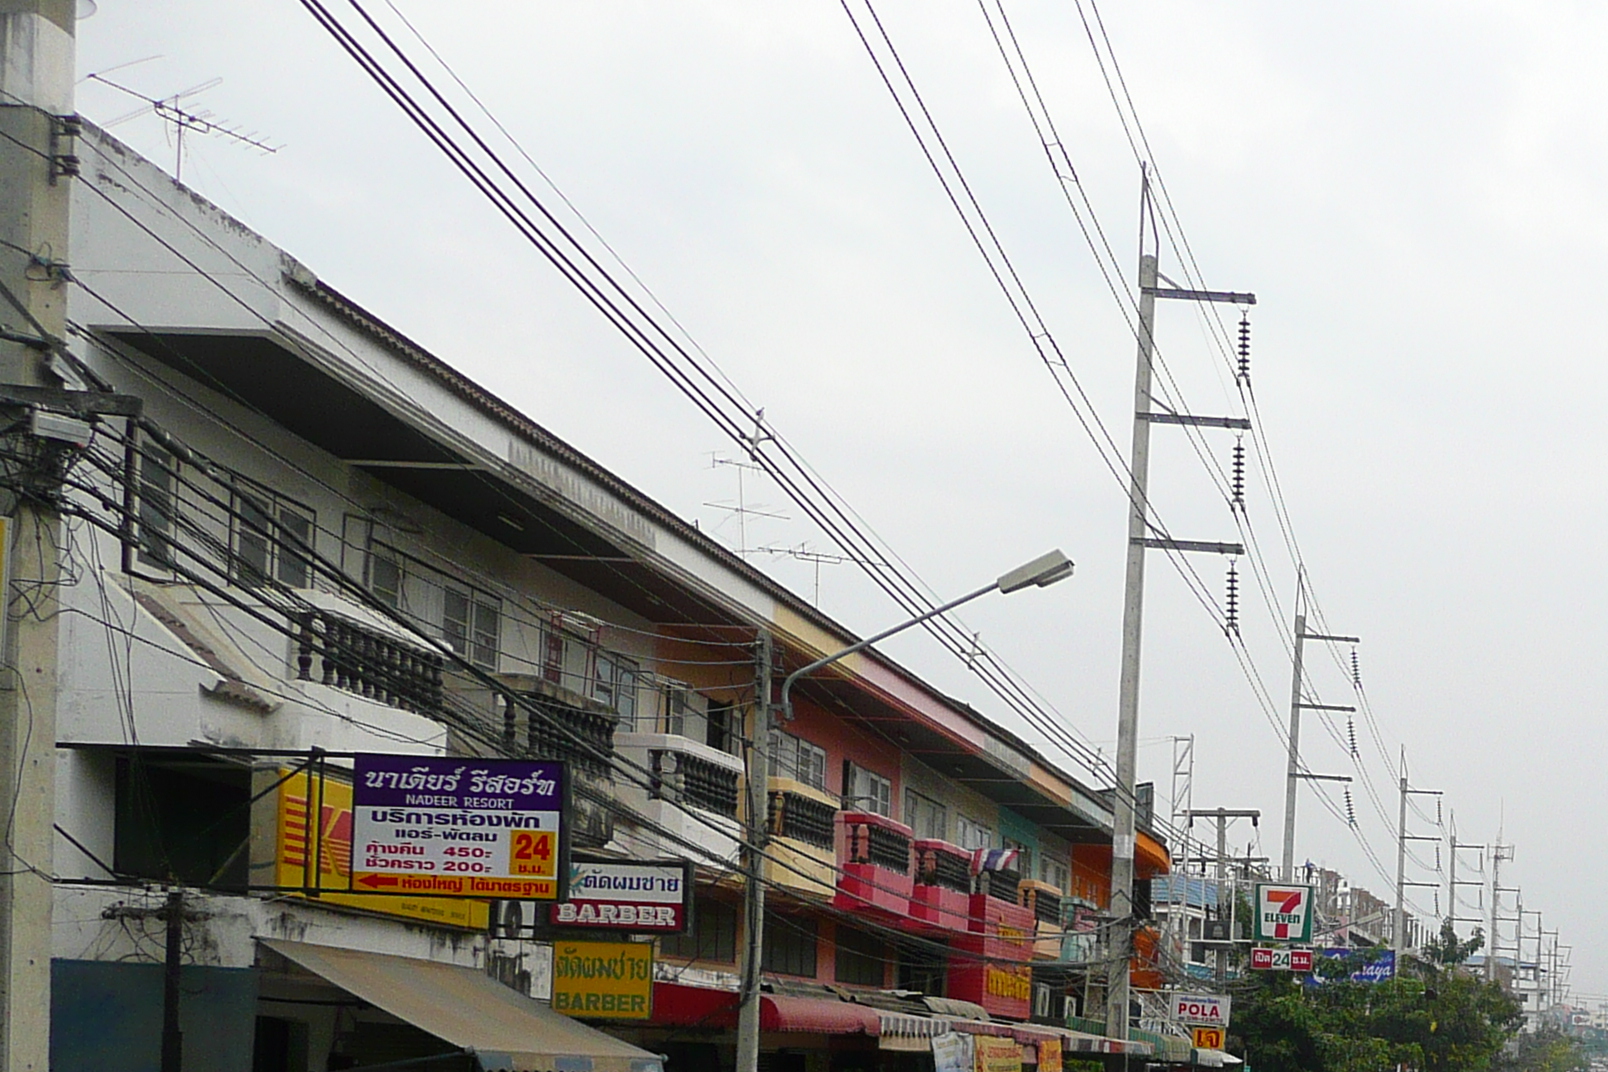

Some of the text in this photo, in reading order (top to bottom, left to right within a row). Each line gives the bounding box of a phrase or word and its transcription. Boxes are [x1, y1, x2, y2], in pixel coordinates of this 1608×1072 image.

[405, 793, 515, 810] NADEER RESORT
[371, 808, 540, 829] บริการห้องพัก
[514, 833, 550, 861] 24
[584, 869, 680, 892] ตัดผมชาย
[557, 903, 676, 926] BARBER
[1273, 952, 1290, 967] 24
[555, 992, 646, 1012] BARBER
[1178, 1002, 1220, 1018] POLA
